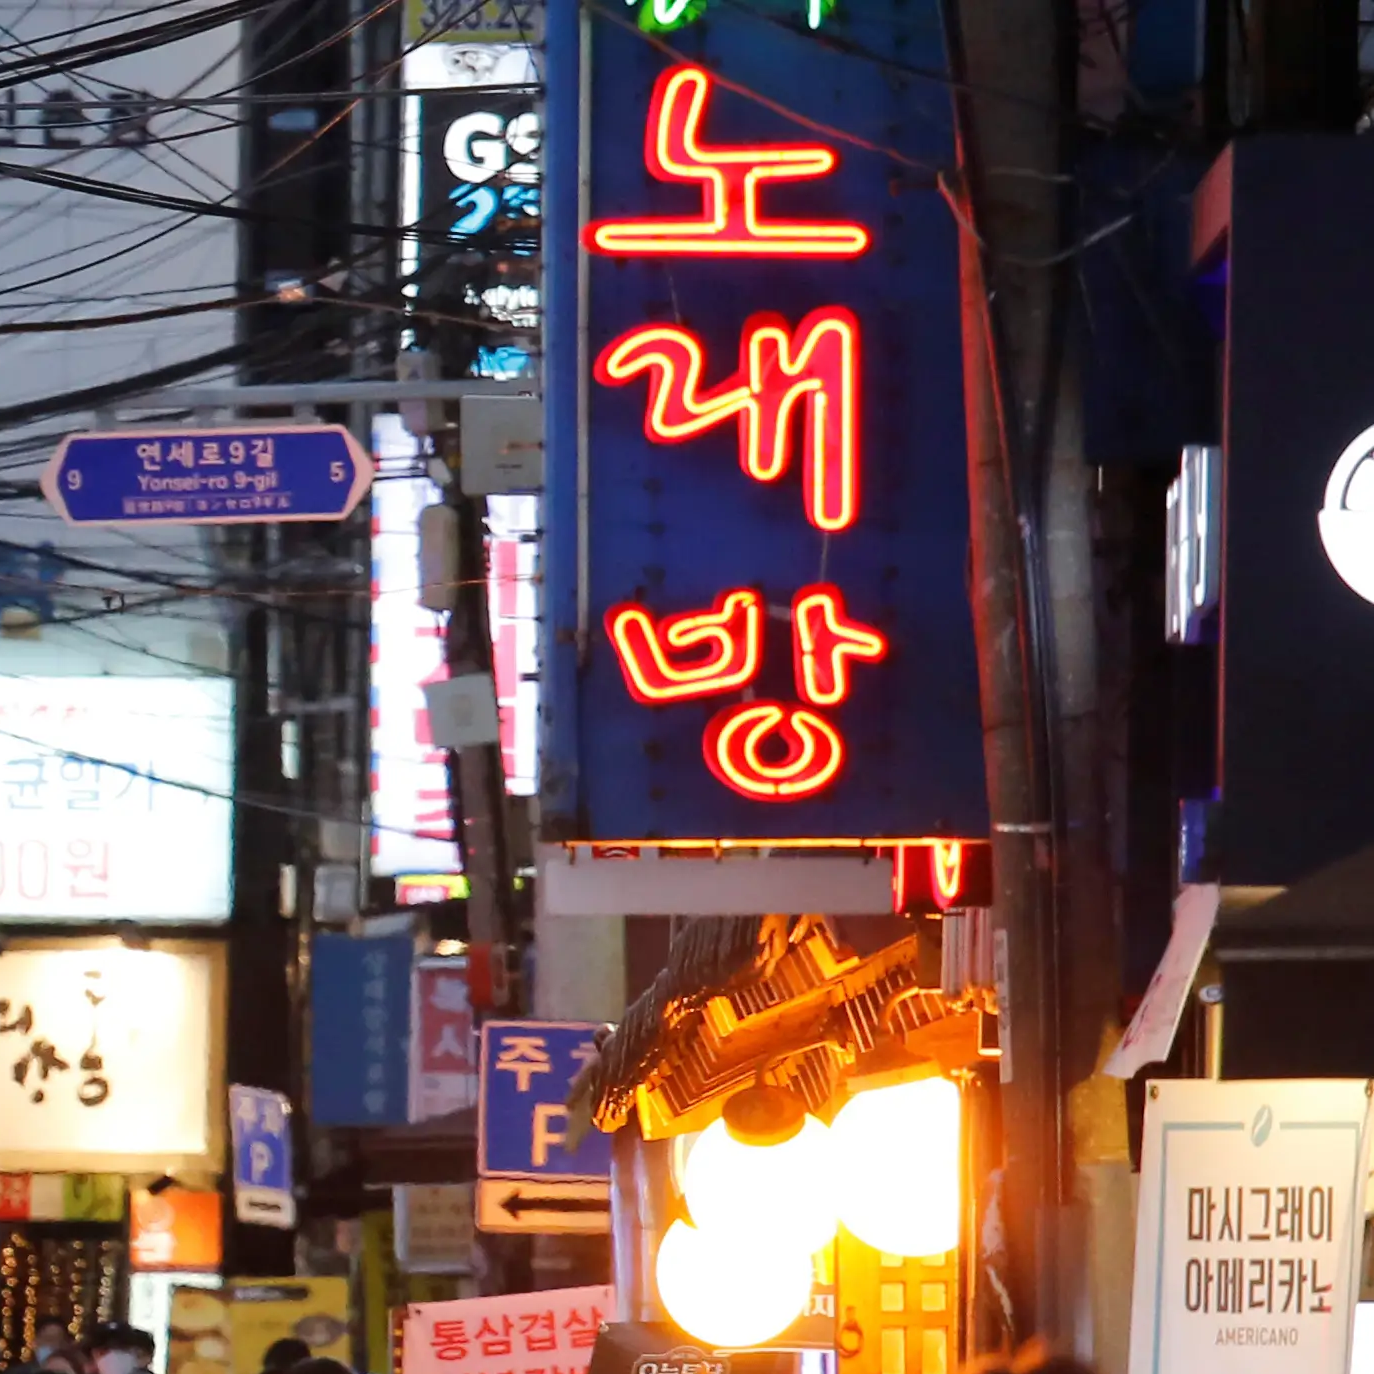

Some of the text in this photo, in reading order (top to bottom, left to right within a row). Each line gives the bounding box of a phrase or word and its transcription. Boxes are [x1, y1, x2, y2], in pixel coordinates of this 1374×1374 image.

[581, 62, 890, 803] 노래방
[137, 438, 275, 471] 연세로9길
[329, 461, 345, 482] 5
[67, 470, 83, 490] 9
[138, 470, 279, 492] Yonsei-ro 9-gil
[250, 1140, 273, 1182] P
[1187, 1185, 1334, 1242] 마시그래이
[1184, 1257, 1333, 1314] 아메리카노
[430, 1305, 604, 1361] 통삼겹살
[1214, 1327, 1299, 1346] AMERICANO
